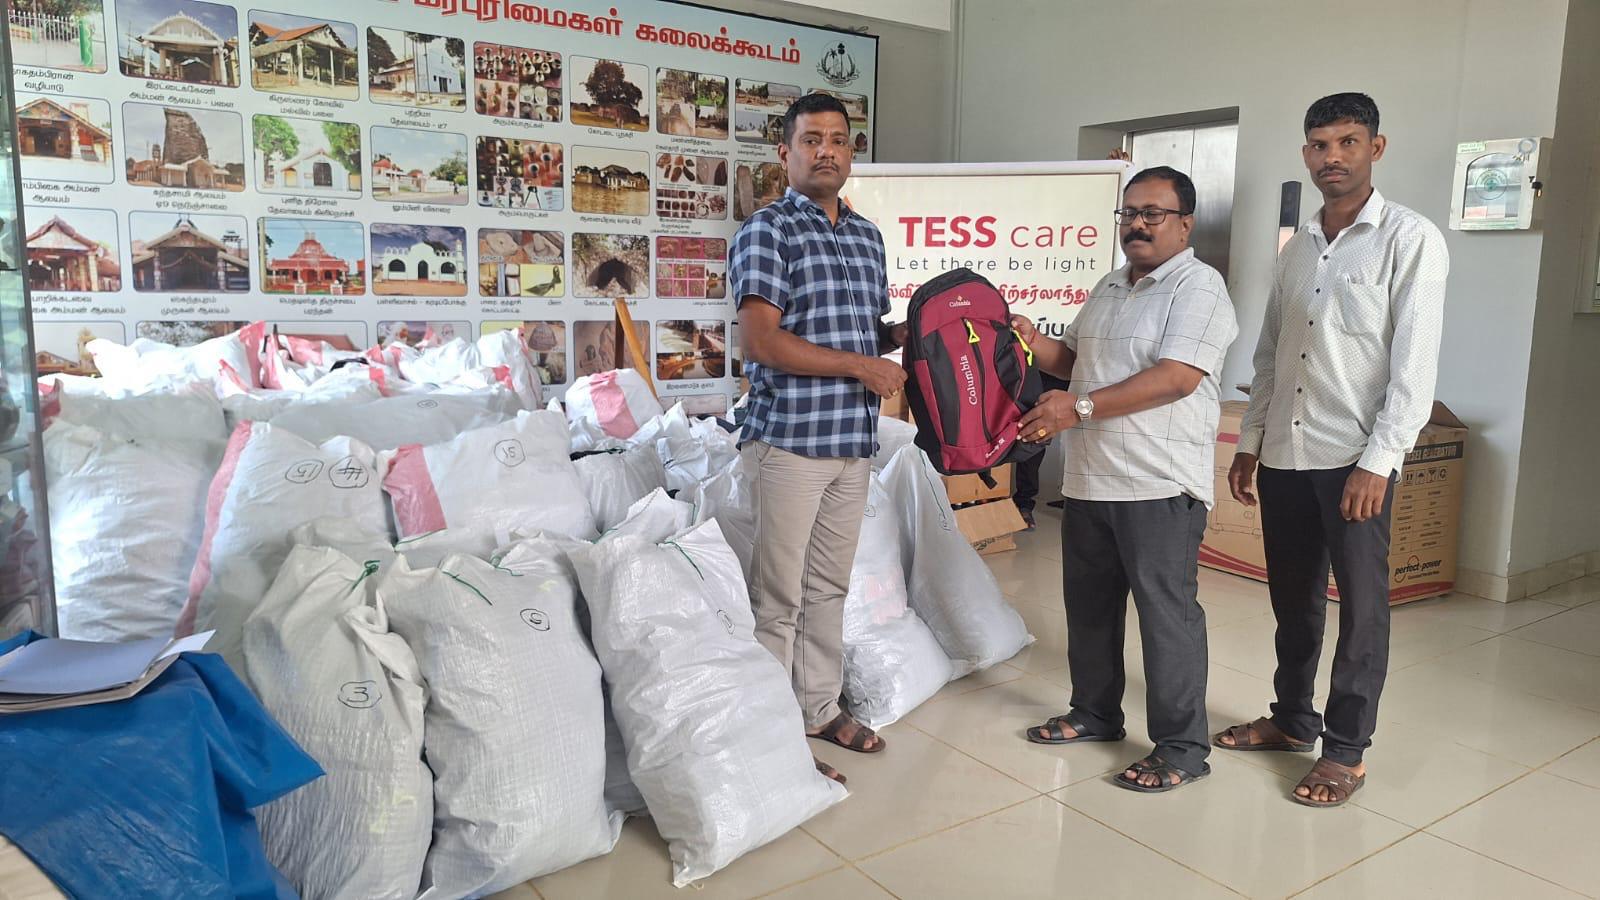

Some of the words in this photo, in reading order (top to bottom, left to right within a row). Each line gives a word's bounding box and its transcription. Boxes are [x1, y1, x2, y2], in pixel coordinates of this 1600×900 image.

[636, 23, 801, 64] கலைக்கூடம்
[33, 194, 70, 203] ஆலயம்
[899, 216, 996, 248] TESS
[1010, 225, 1098, 248] care
[896, 257, 929, 271] Let
[941, 257, 996, 271] there
[1008, 257, 1032, 271] be
[1045, 257, 1096, 273] light
[960, 354, 977, 405] Columbia
[355, 686, 370, 703] 3
